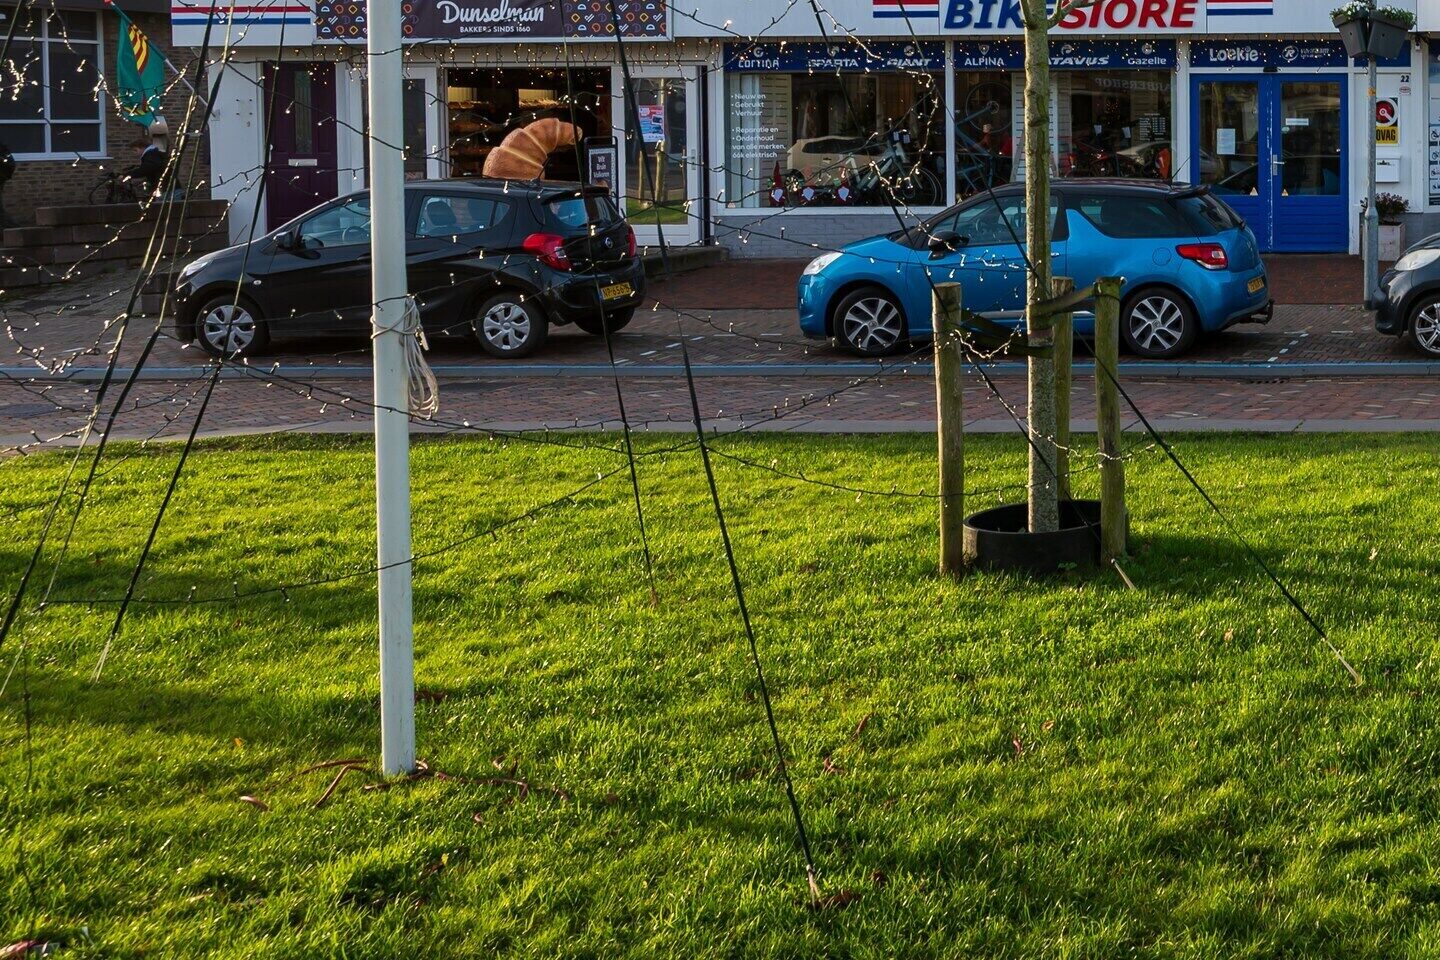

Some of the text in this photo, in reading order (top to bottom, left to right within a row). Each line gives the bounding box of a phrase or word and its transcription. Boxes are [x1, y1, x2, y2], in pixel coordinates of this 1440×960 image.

[809, 58, 859, 67] SPARTA
[886, 58, 933, 67] GIANT
[964, 58, 1004, 66] ALPINA
[1128, 57, 1167, 65] Gazelle
[1400, 75, 1410, 83] 22
[735, 126, 769, 134] Reparatie
[1376, 129, 1396, 141] OVAG
